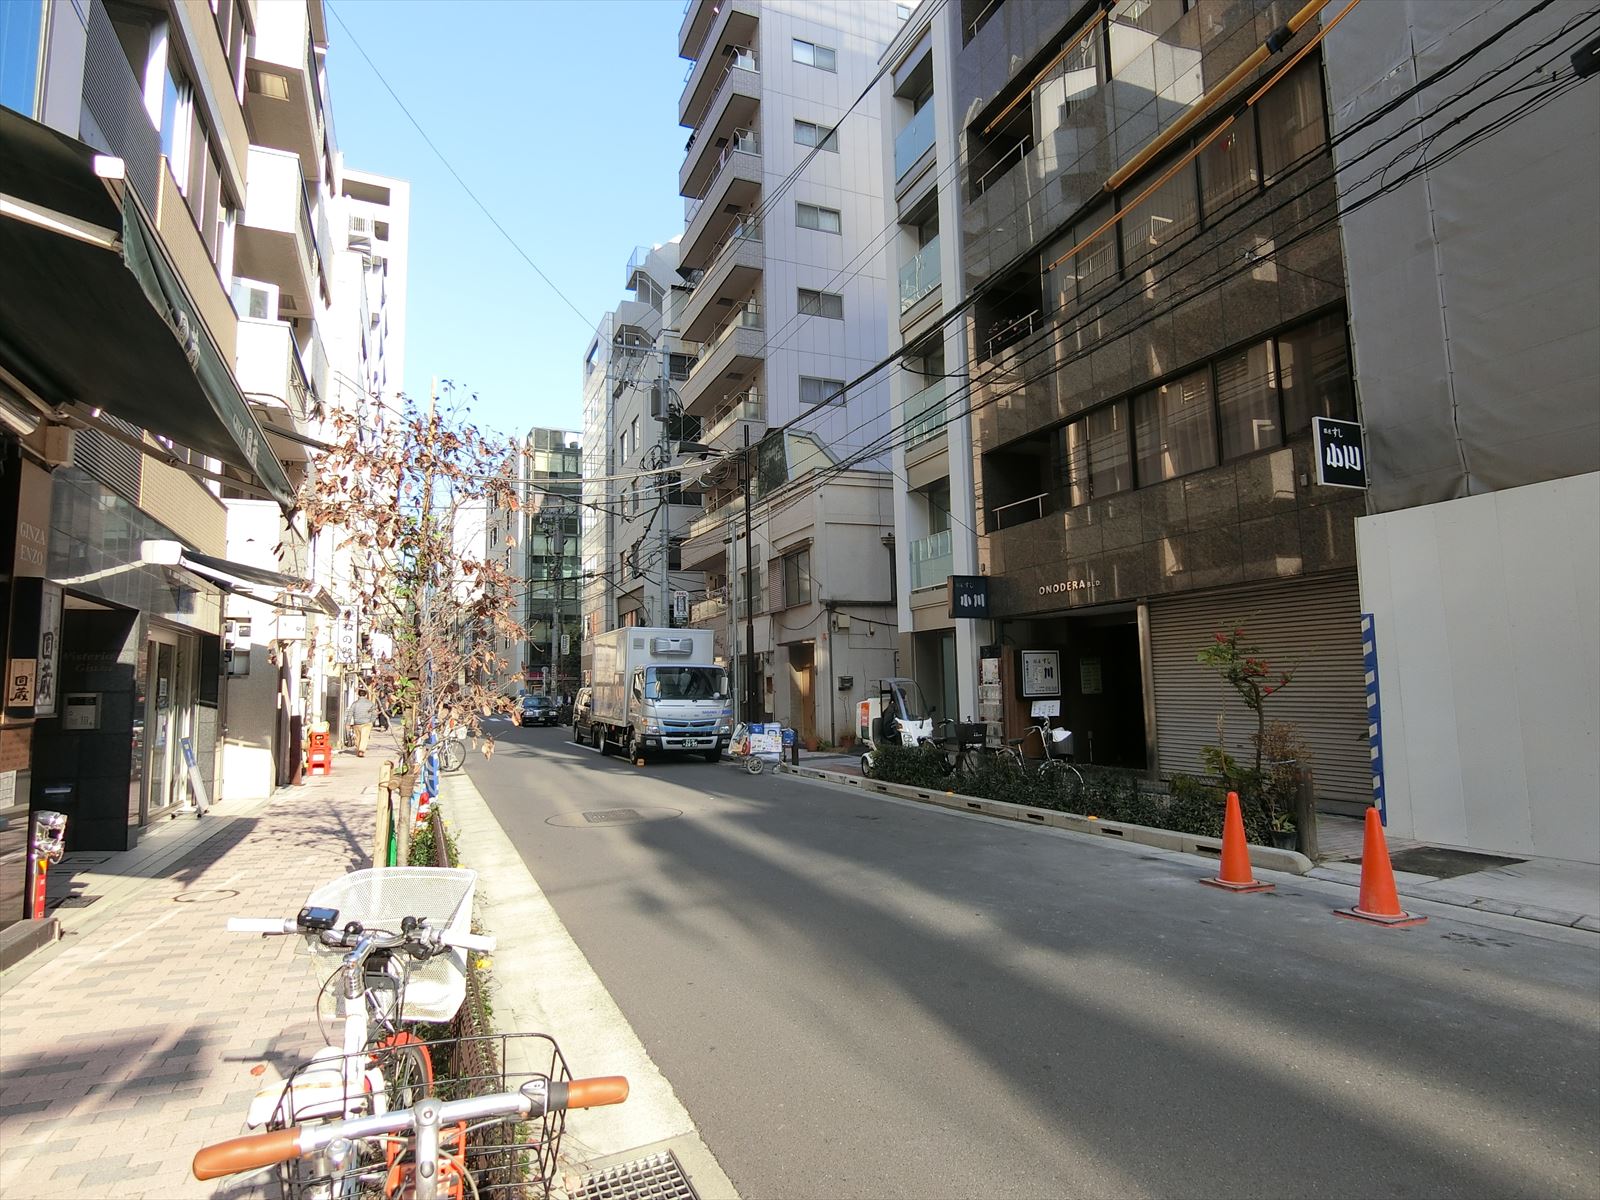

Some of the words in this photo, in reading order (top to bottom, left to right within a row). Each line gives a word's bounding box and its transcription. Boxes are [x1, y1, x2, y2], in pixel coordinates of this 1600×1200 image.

[1326, 443, 1361, 471] 小川
[20, 521, 45, 546] GINZA
[20, 544, 44, 566] ENZO
[1038, 579, 1086, 595] ONODERA
[1086, 580, 1101, 588] BLD
[960, 593, 985, 608] 小川
